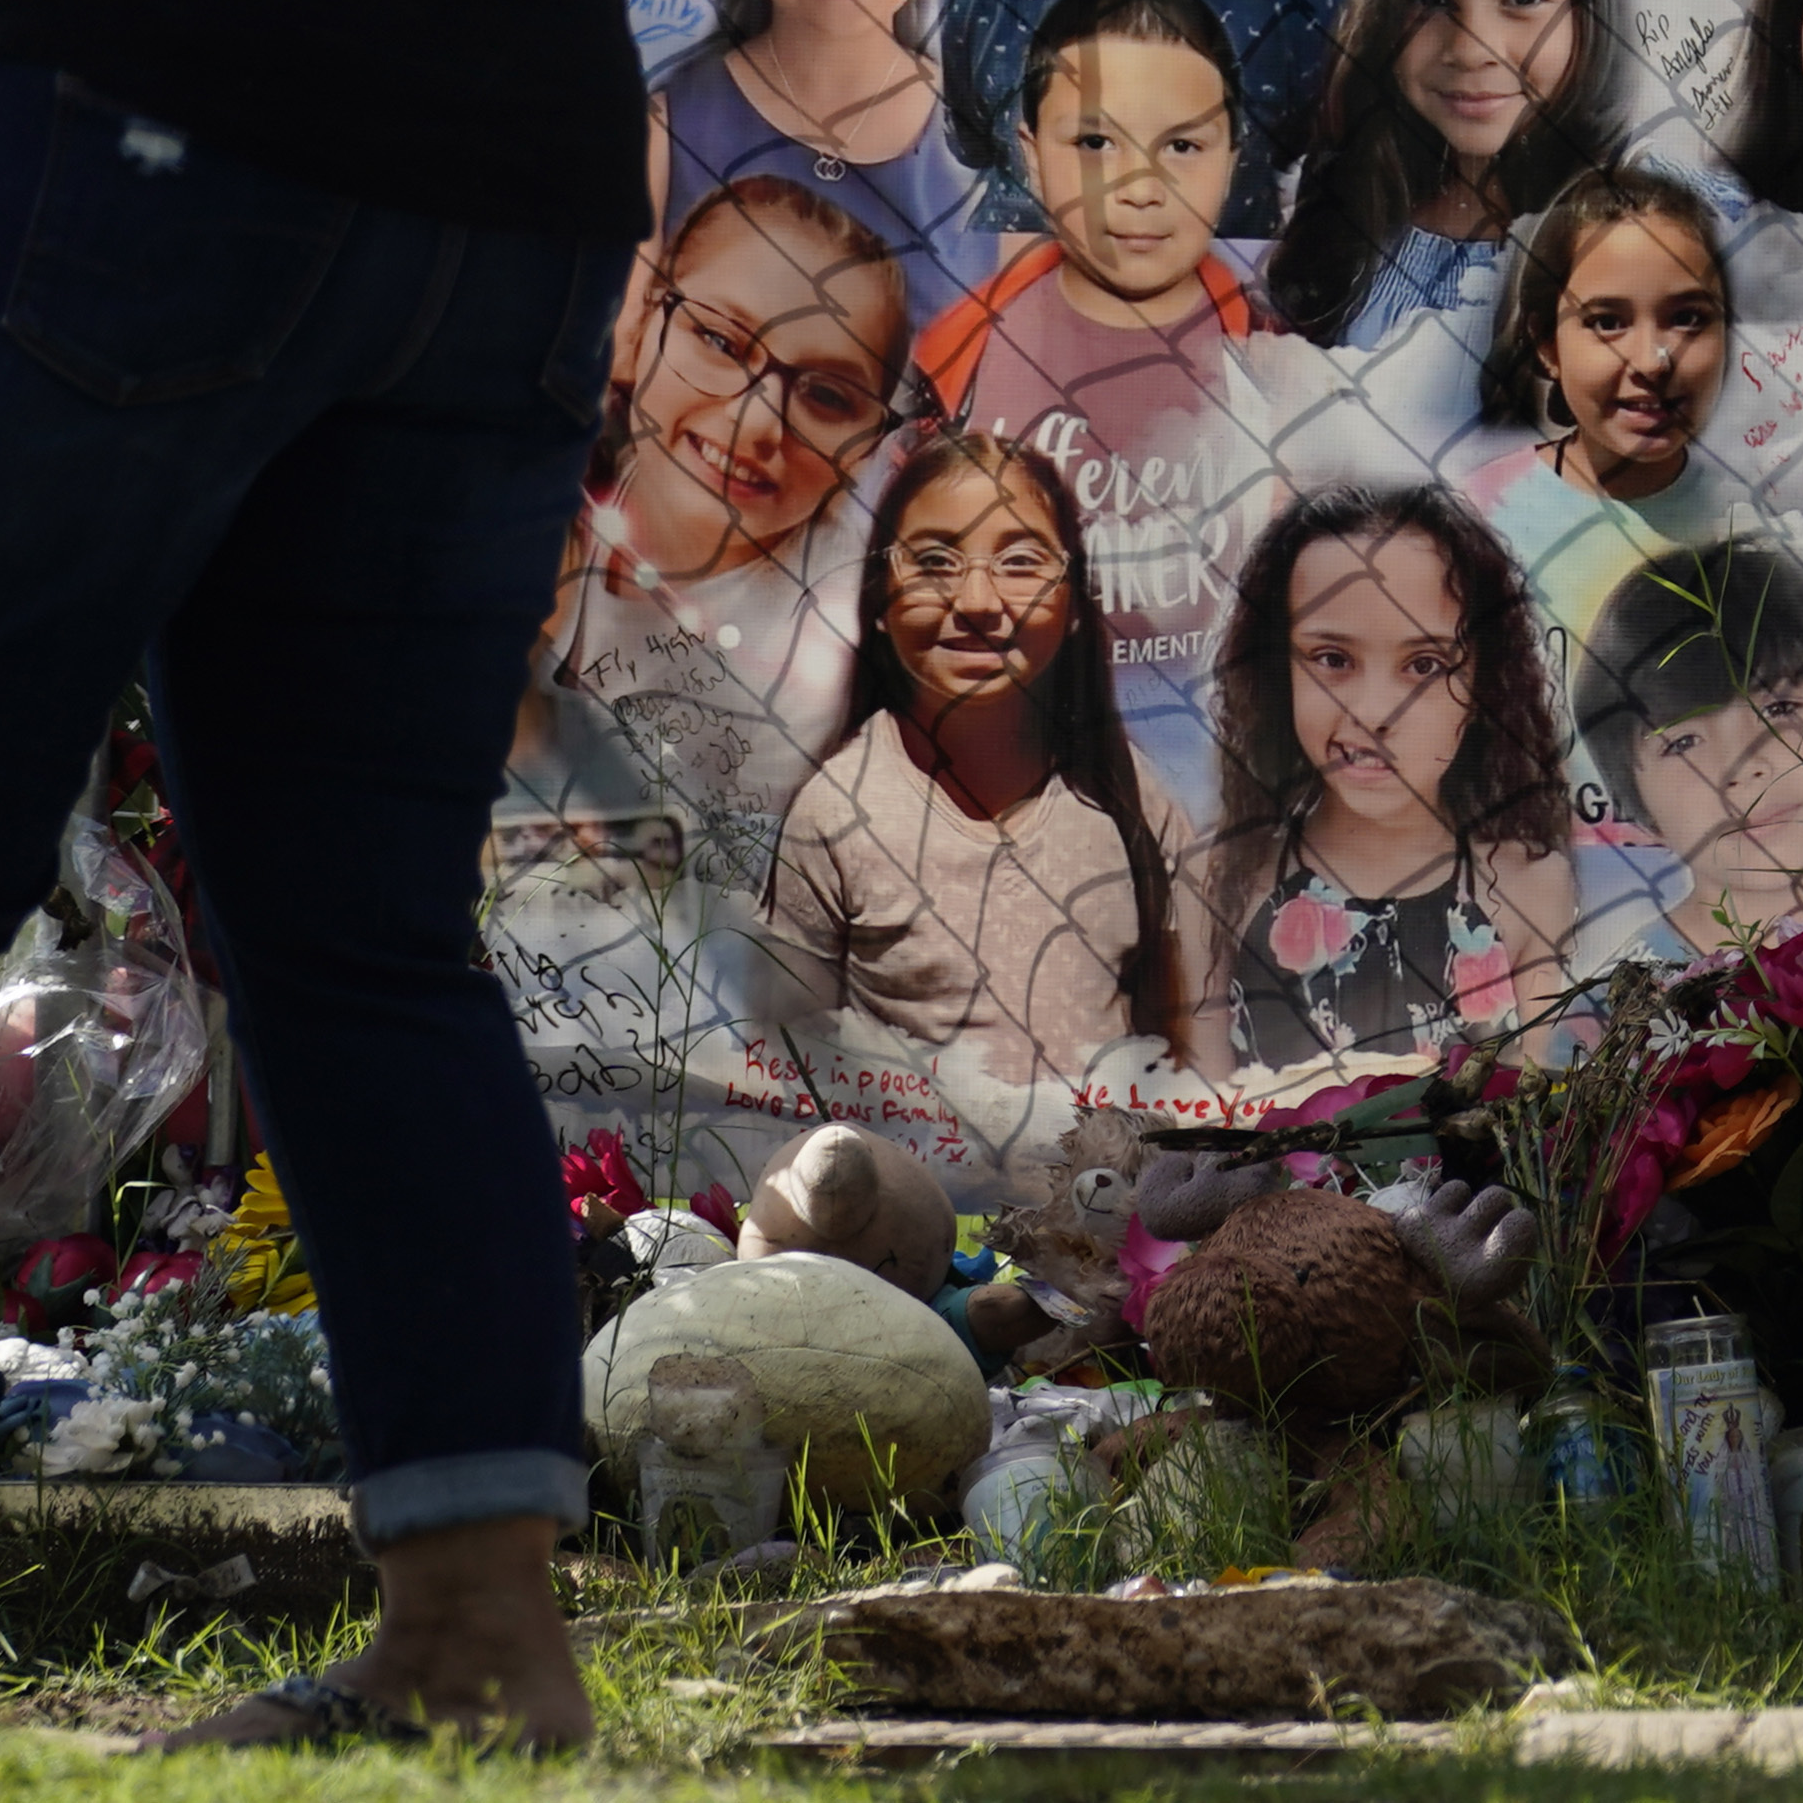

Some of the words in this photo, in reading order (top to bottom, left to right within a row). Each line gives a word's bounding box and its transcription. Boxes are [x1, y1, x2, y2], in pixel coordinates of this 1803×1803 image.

[746, 1038, 819, 1084] Rest
[830, 1053, 851, 1087] in
[726, 1081, 784, 1118] Love
